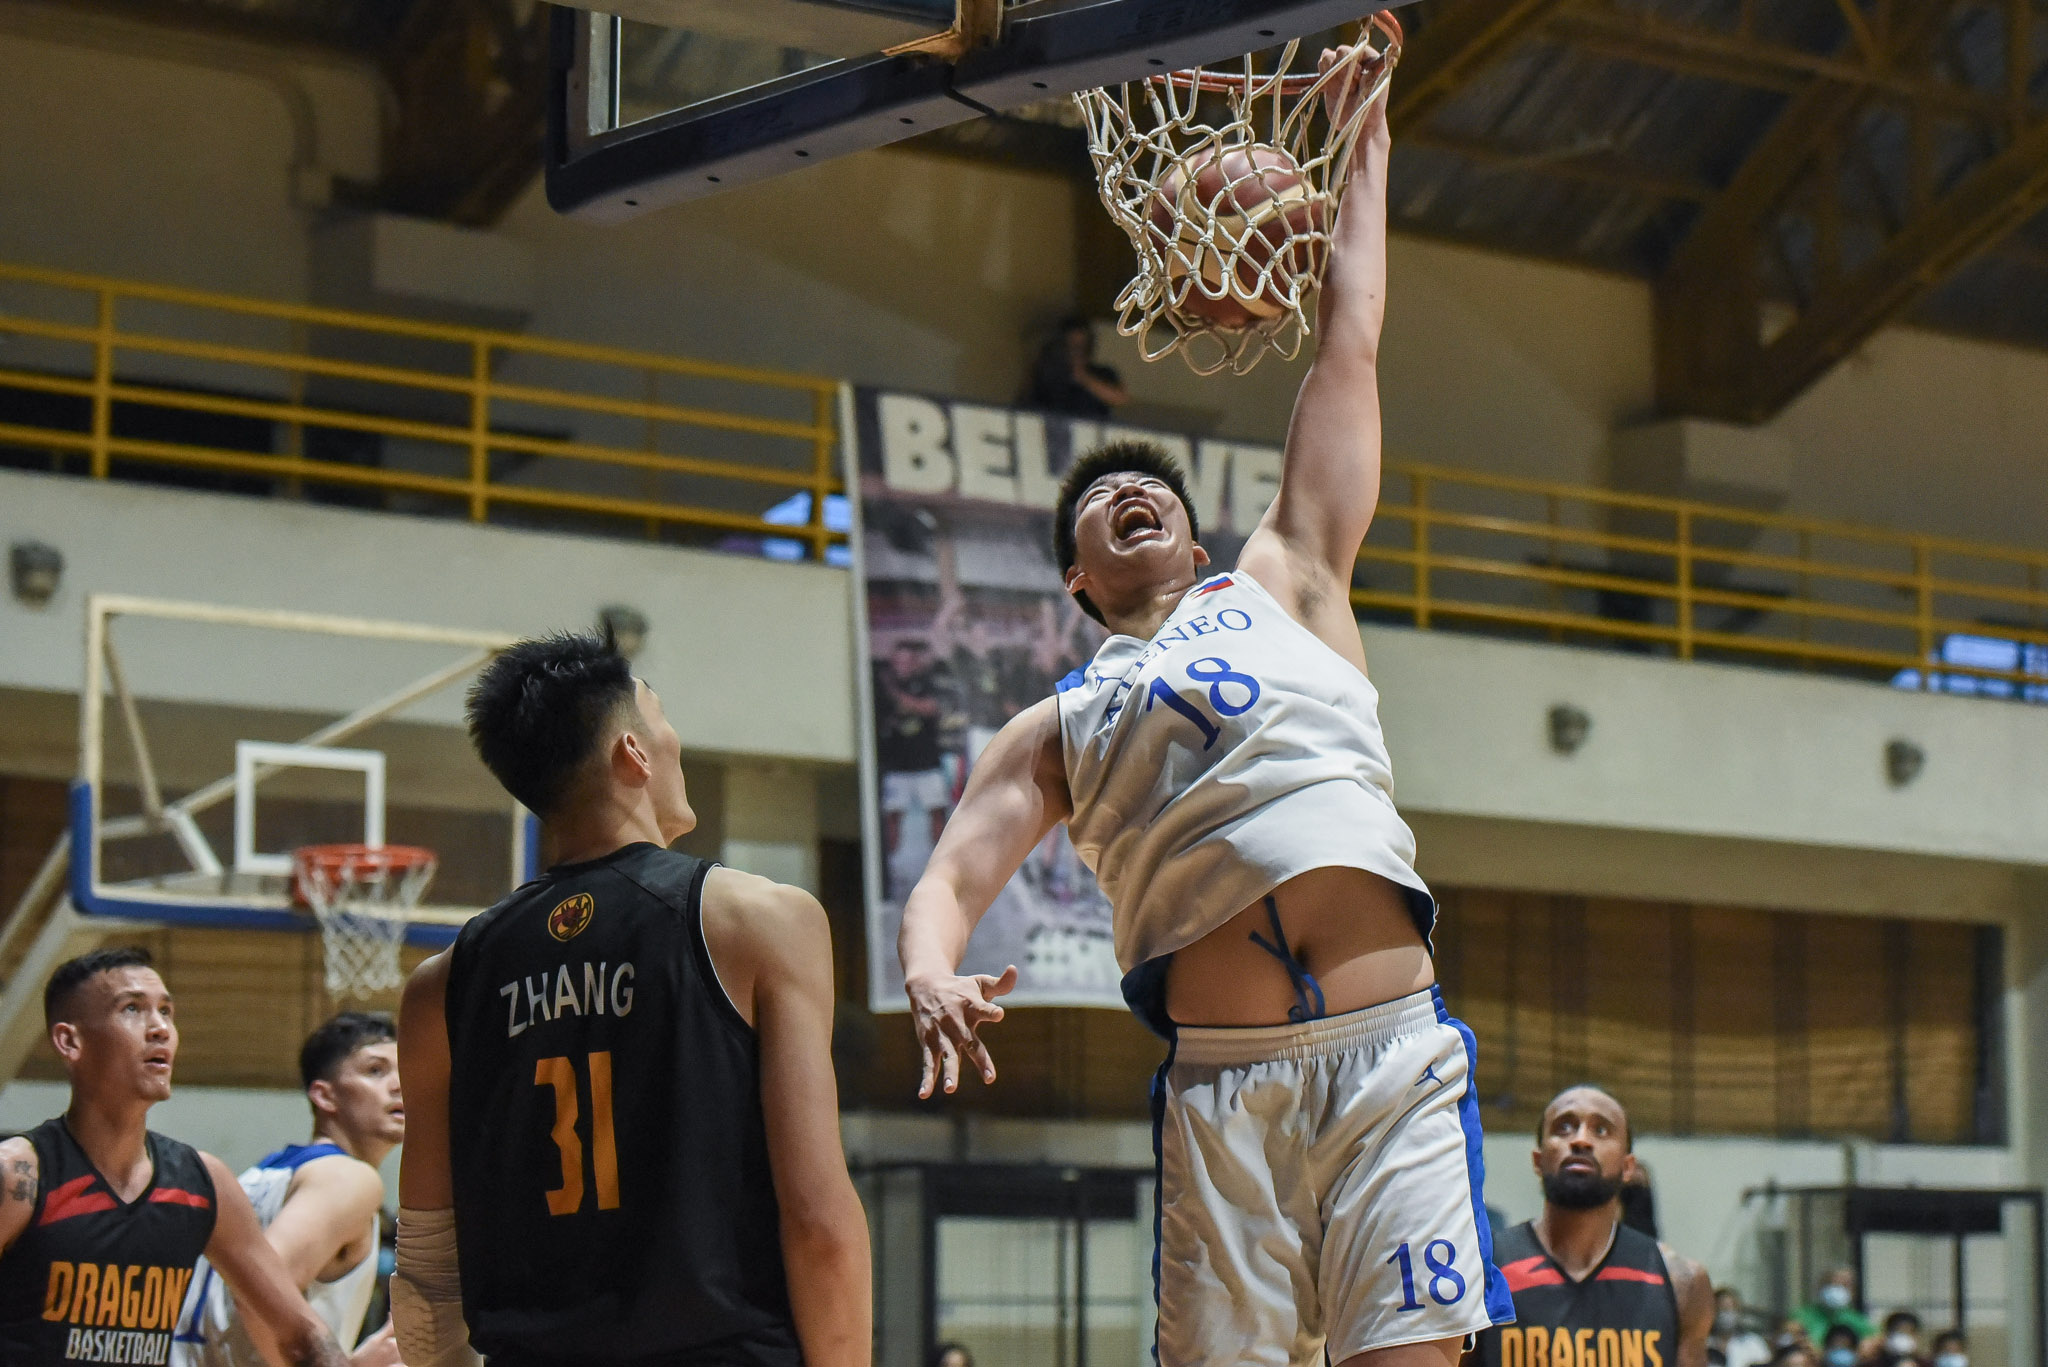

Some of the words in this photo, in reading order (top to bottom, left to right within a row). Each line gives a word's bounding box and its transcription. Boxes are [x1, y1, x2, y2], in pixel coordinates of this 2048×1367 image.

[877, 393, 1284, 536] BELVE
[1146, 657, 1260, 750] 18
[500, 961, 634, 1038] ZHANG
[534, 1051, 620, 1215] 31
[41, 1260, 193, 1330] DRAGON
[1387, 1239, 1466, 1312] 18
[65, 1327, 170, 1365] BASKETBALL
[1501, 1326, 1664, 1367] DRAGONS
